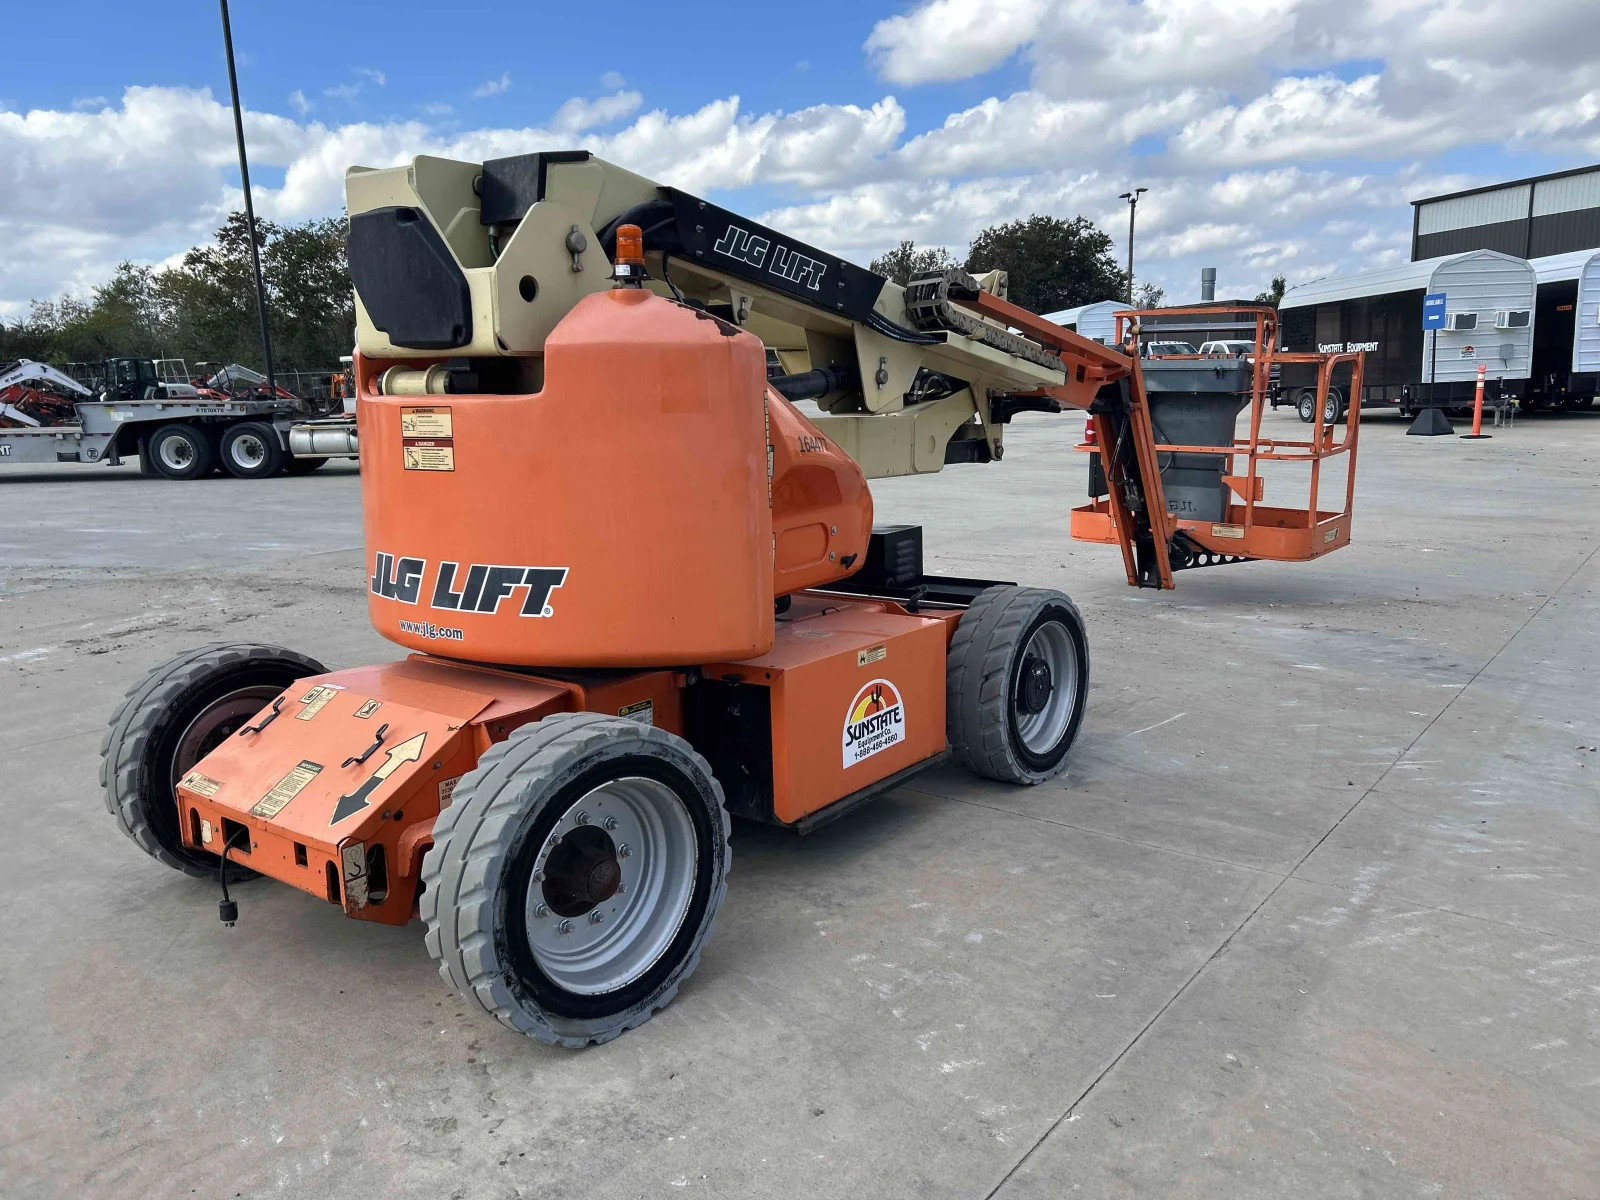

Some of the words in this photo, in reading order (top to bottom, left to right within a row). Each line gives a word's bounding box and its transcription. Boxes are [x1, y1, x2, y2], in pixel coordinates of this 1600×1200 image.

[714, 224, 771, 269] JLG
[768, 244, 828, 291] LIFT
[1317, 342, 1343, 353] SUNSTATE
[1346, 341, 1379, 352] EQUIPMENT
[370, 550, 426, 605] JLG
[430, 561, 570, 617] LIFT
[399, 619, 464, 641] www.jlg.com
[845, 706, 902, 747] SUNSTATE
[857, 730, 885, 749] Equipment
[445, 779, 457, 787] MAX
